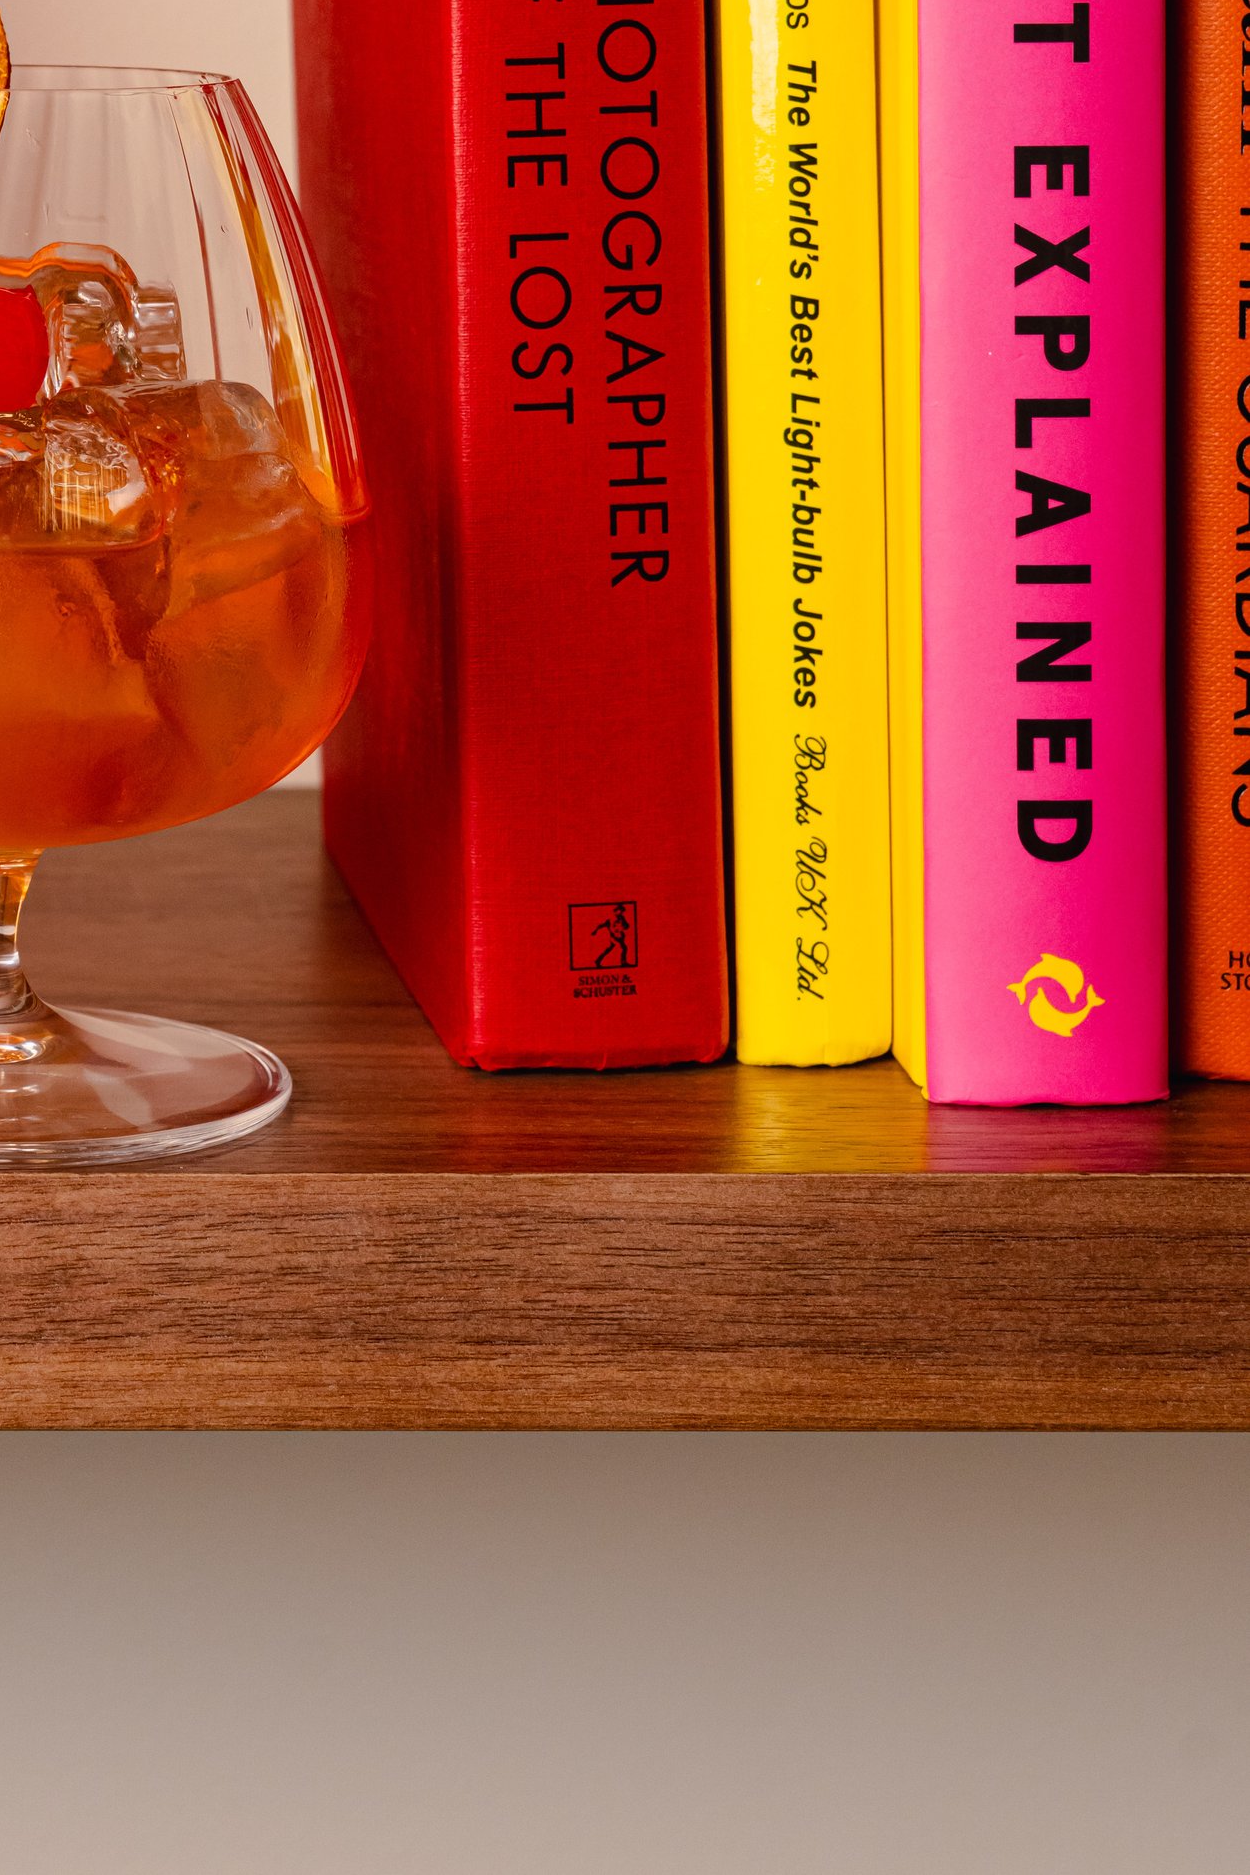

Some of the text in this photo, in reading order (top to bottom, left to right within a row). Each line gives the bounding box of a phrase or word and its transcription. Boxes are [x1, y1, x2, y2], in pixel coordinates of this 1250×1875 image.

[505, 54, 568, 188] THE
[510, 231, 574, 425] LOST
[782, 59, 822, 709] The World's Best Light-bulb Jokes
[1012, 145, 1094, 863] EXPLAINED
[793, 733, 830, 1001] Books UK Ltd.
[573, 985, 638, 998] SCHUSTER
[579, 974, 633, 985] SIMON &
